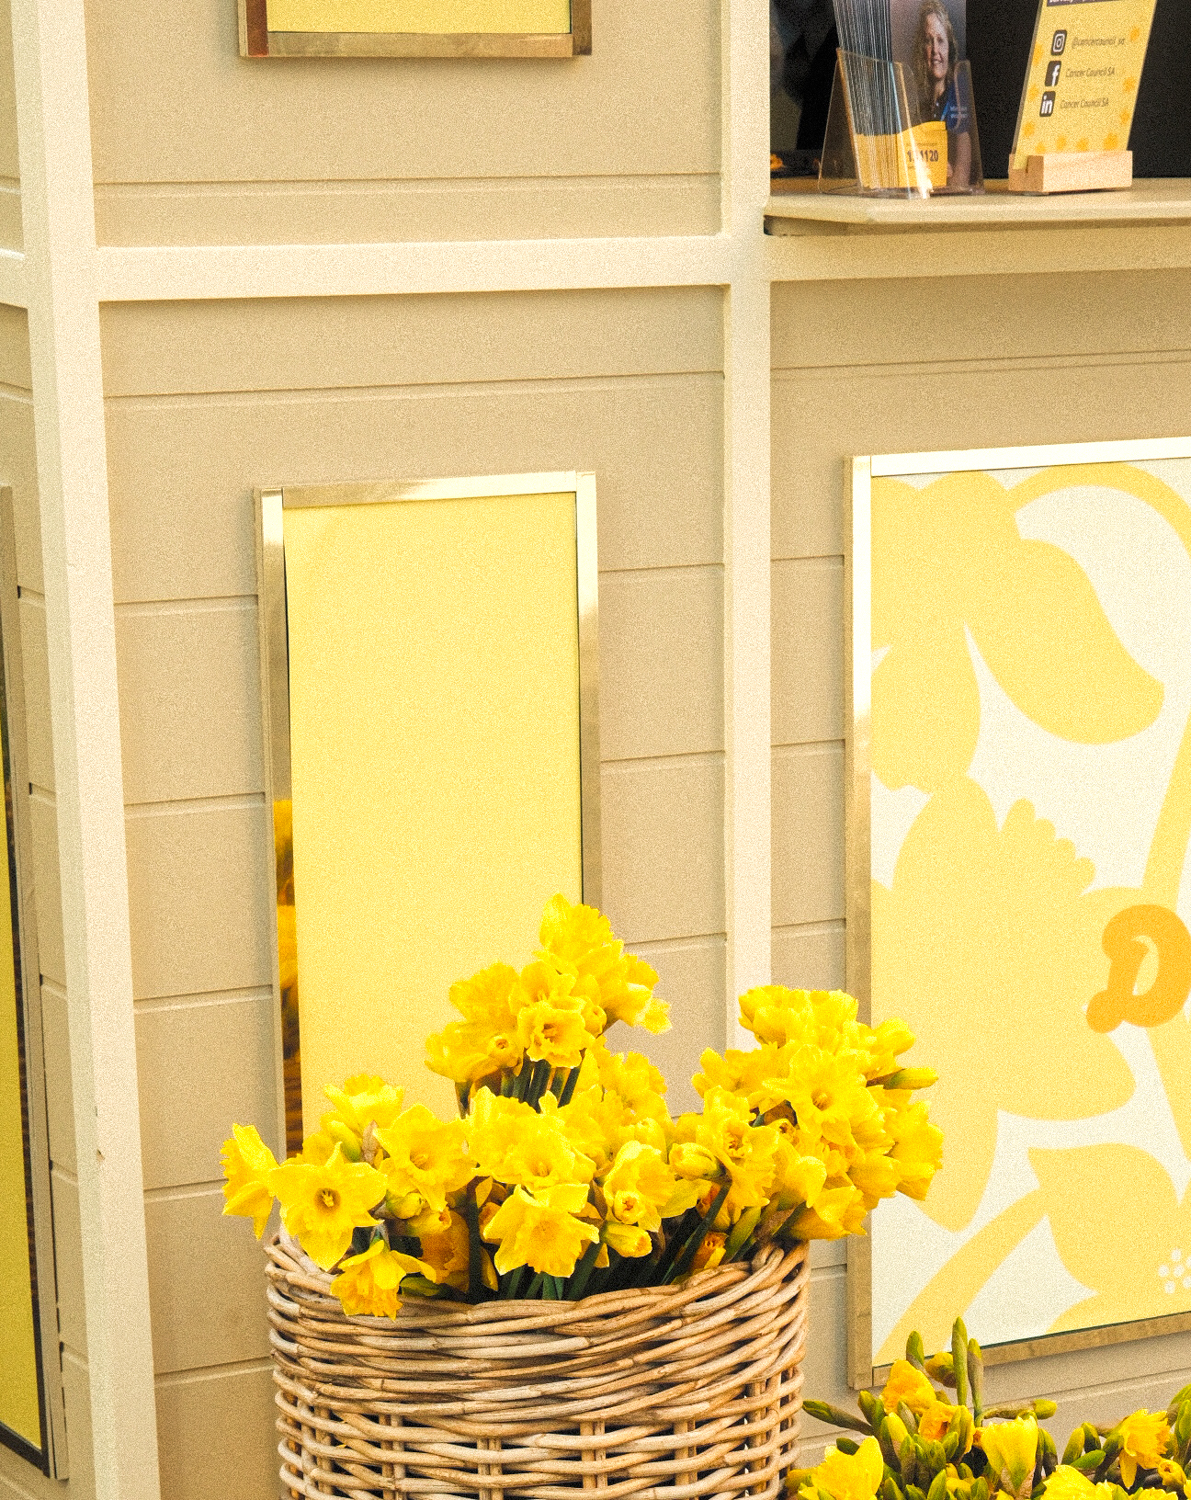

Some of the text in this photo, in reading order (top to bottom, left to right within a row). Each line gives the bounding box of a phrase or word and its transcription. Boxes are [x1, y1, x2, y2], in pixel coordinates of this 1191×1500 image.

[1065, 68, 1085, 78] Cancer
[1086, 67, 1107, 77] Council
[1060, 99, 1080, 109] Cancer
